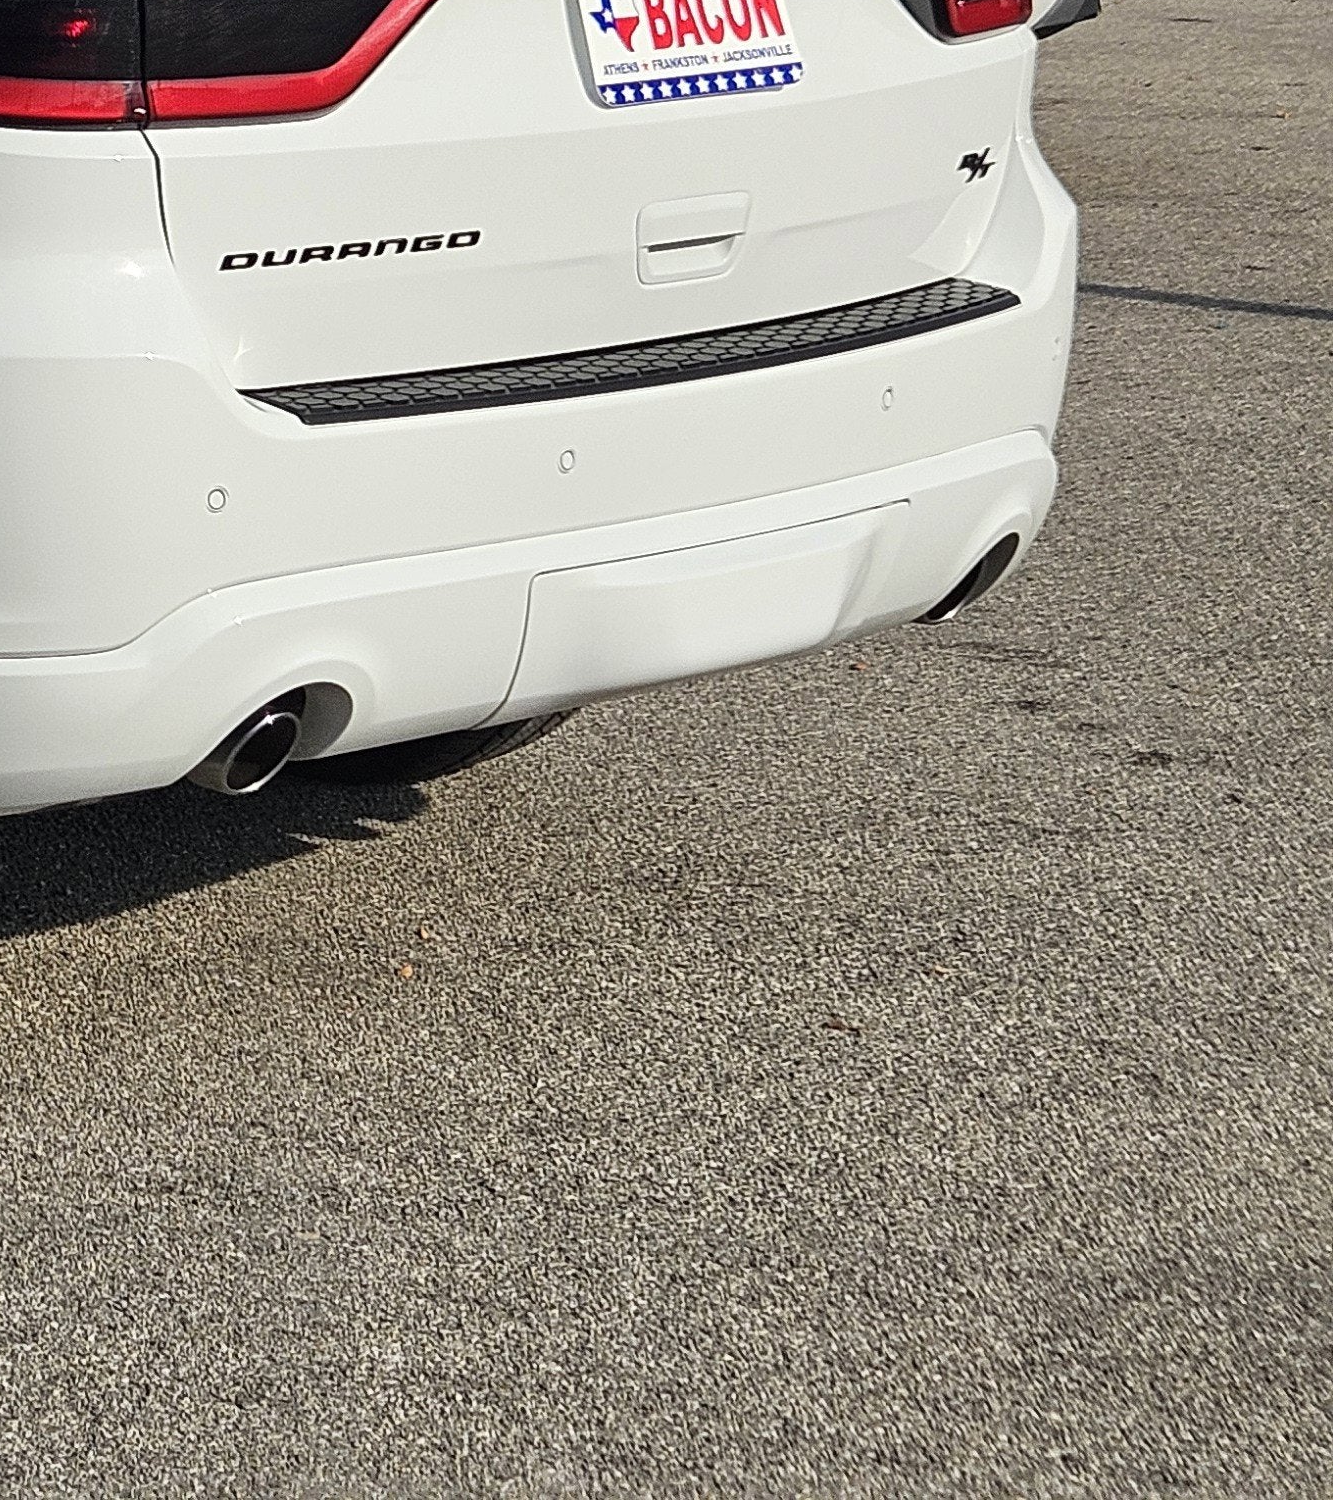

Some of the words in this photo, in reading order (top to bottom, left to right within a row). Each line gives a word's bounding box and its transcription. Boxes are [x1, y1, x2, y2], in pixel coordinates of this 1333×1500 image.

[603, 61, 641, 77] ATHENS
[651, 54, 710, 73] FRANKSTON
[722, 43, 794, 63] JACKSONVILLE
[218, 229, 482, 272] DURANGO
